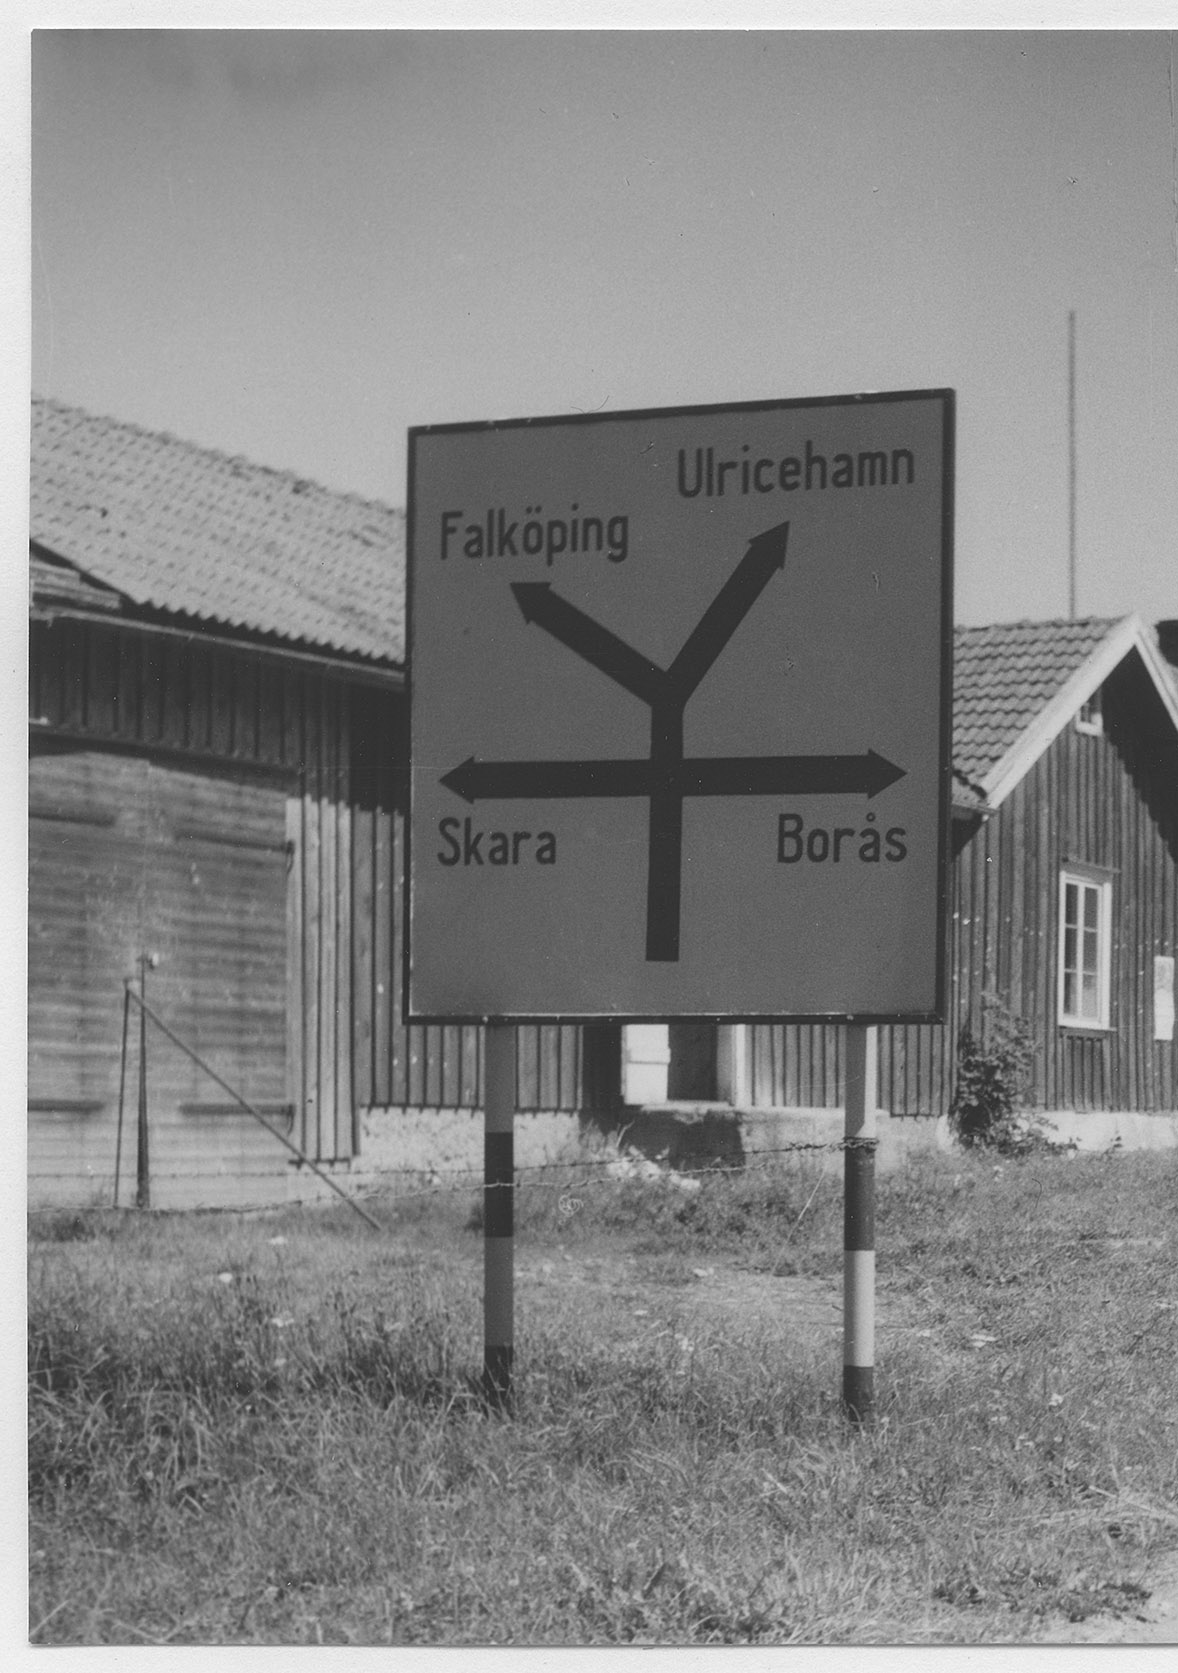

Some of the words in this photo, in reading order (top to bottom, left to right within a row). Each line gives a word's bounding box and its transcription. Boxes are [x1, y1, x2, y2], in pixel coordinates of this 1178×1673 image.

[677, 440, 915, 498] Ulricehamn
[440, 504, 629, 567] Falköping
[437, 816, 557, 867] Skara
[777, 812, 908, 864] Borås
